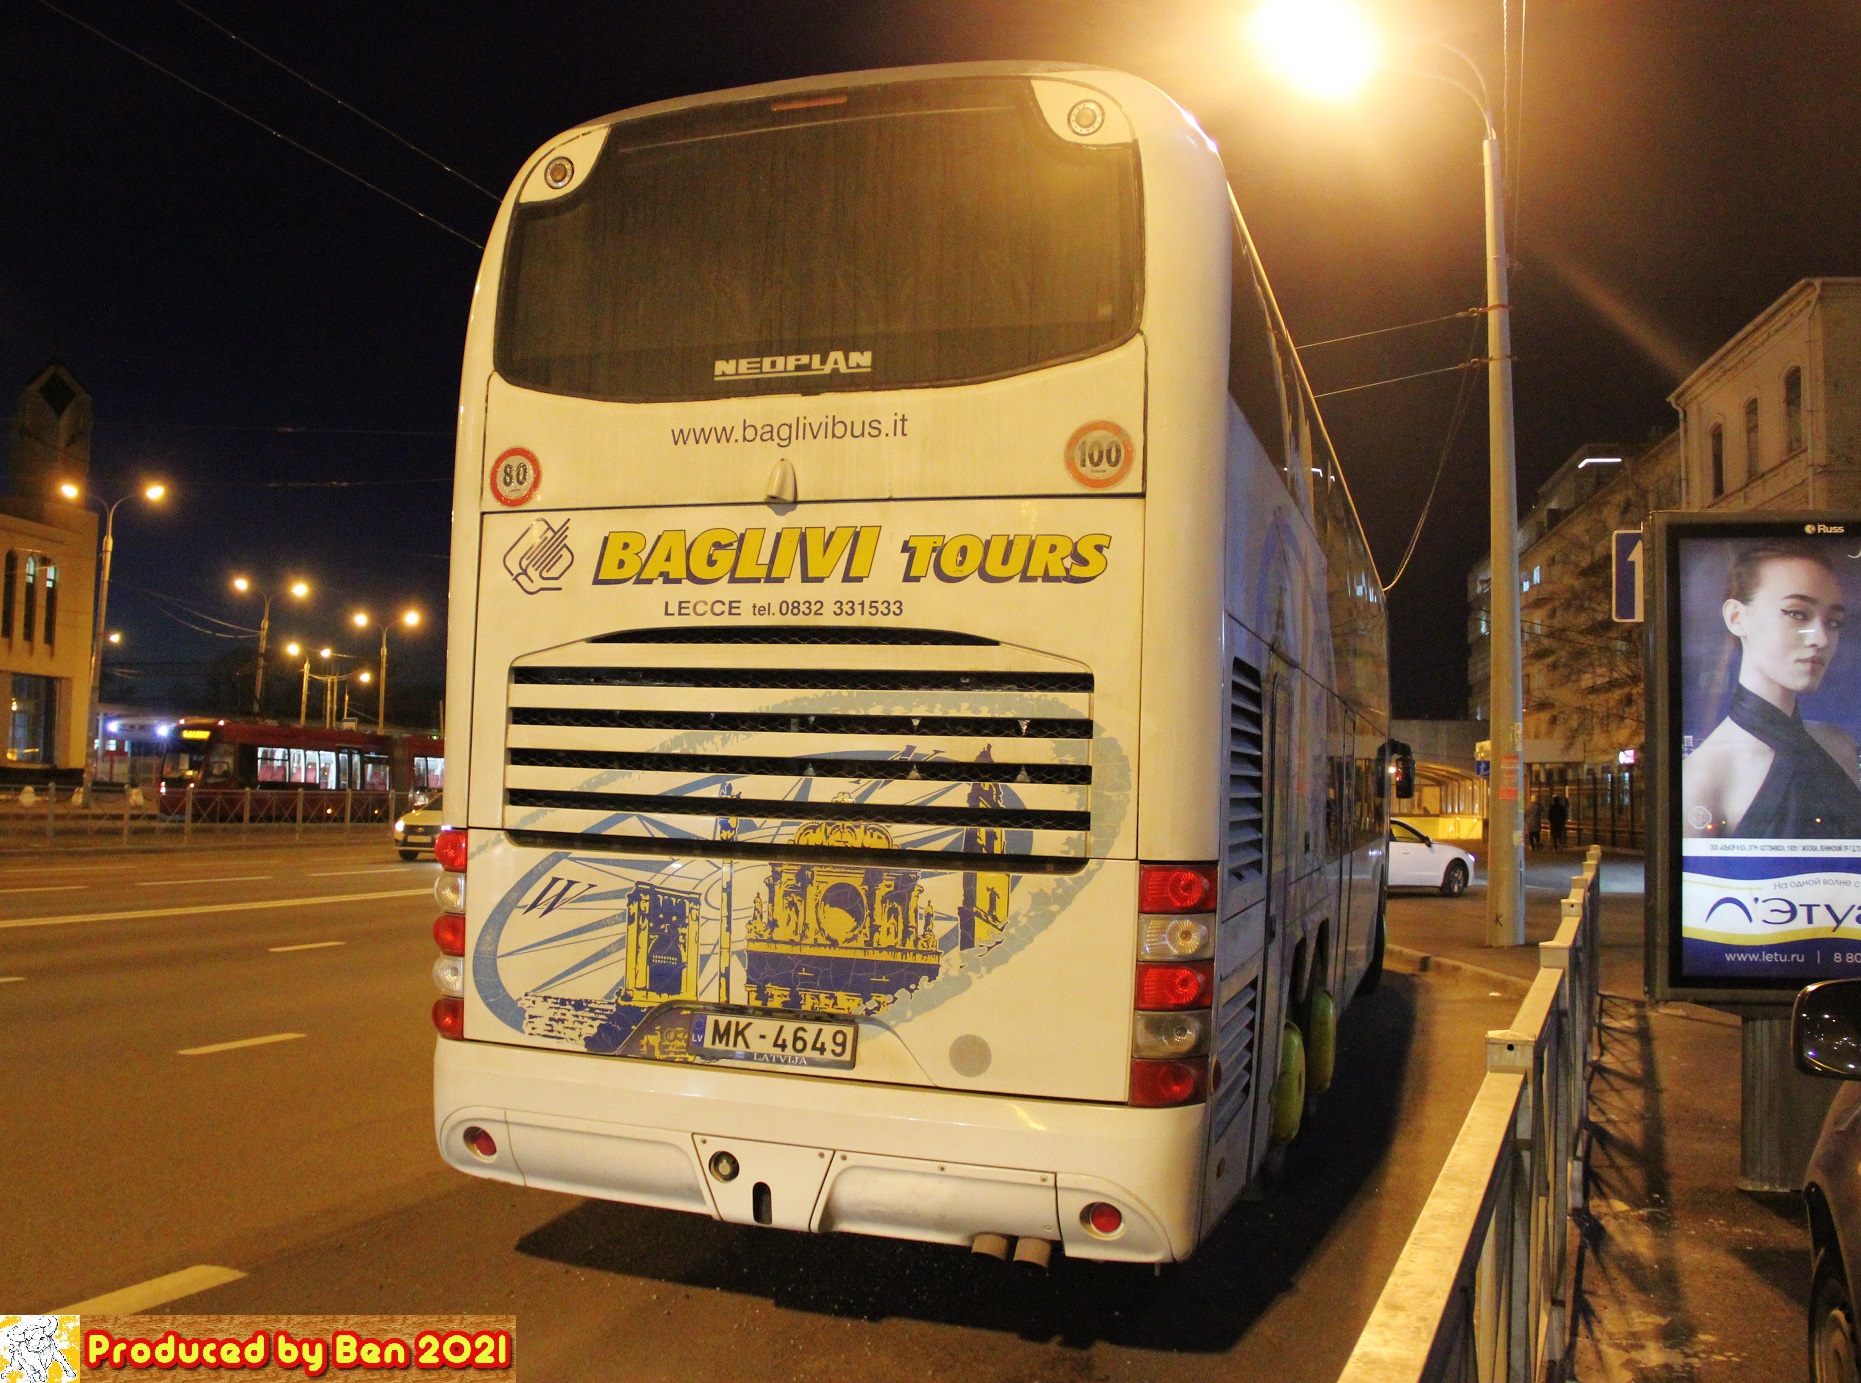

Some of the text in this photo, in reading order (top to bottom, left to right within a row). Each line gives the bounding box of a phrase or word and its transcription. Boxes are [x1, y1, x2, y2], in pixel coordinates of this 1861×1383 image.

[714, 351, 872, 380] NEOPLAN
[671, 412, 908, 448] www.baglivibus.it
[1079, 440, 1122, 468] 100
[503, 462, 527, 487] 80
[1817, 523, 1845, 534] Russ
[592, 526, 1112, 586] BAGLIVI TOURS
[664, 600, 904, 617] LECCE tel. 0832 331533
[1773, 882, 1788, 890] На
[1790, 877, 1821, 888] одной
[1822, 878, 1852, 887] волне
[522, 876, 598, 919] W
[1725, 950, 1805, 963] www.letu.ru
[1833, 952, 1842, 963] 8
[691, 1033, 704, 1043] LV
[711, 1019, 848, 1058] MK-4649
[753, 1052, 808, 1066] LATVIJA
